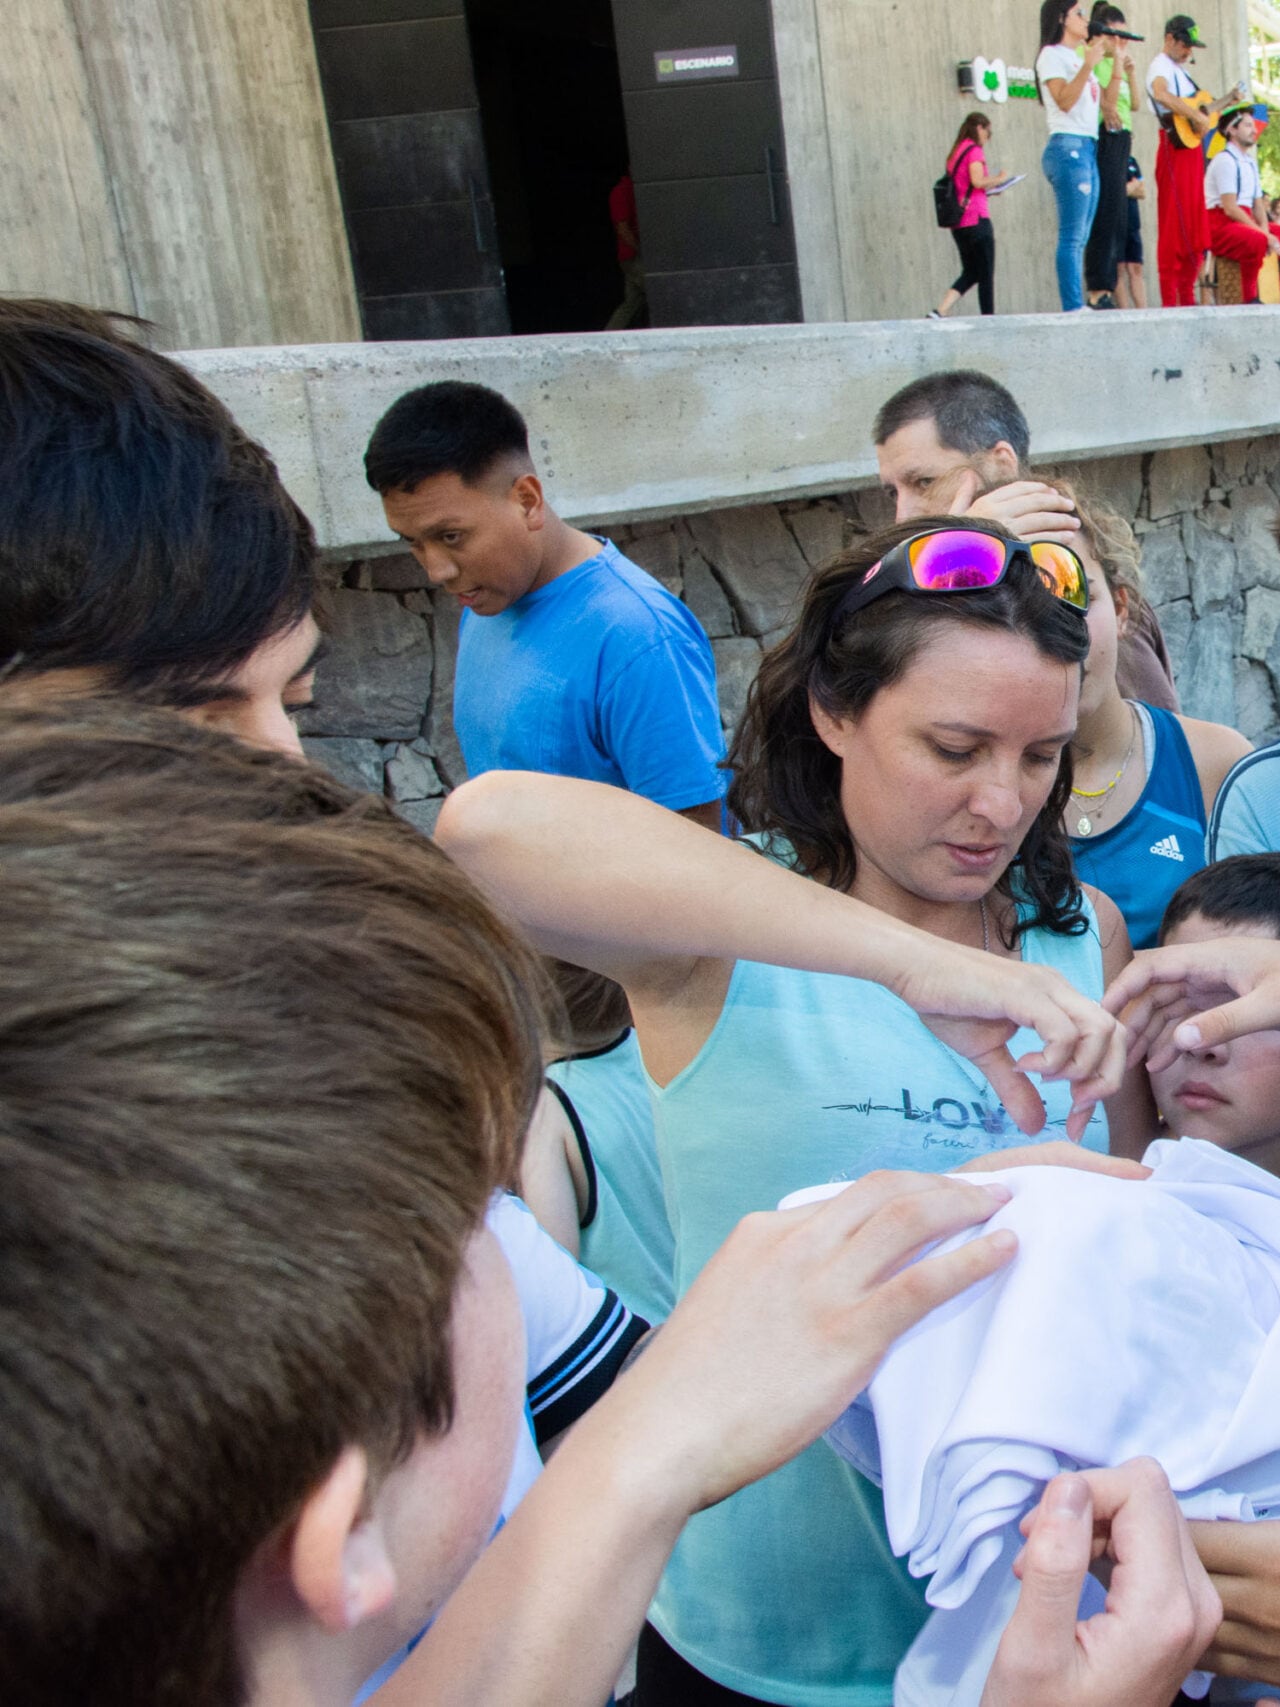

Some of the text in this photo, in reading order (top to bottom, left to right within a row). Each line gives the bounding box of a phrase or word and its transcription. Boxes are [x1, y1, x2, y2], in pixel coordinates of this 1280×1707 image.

[675, 55, 735, 71] ESCENARIO
[1150, 846, 1184, 862] adidas
[902, 1088, 1046, 1134] LOV
